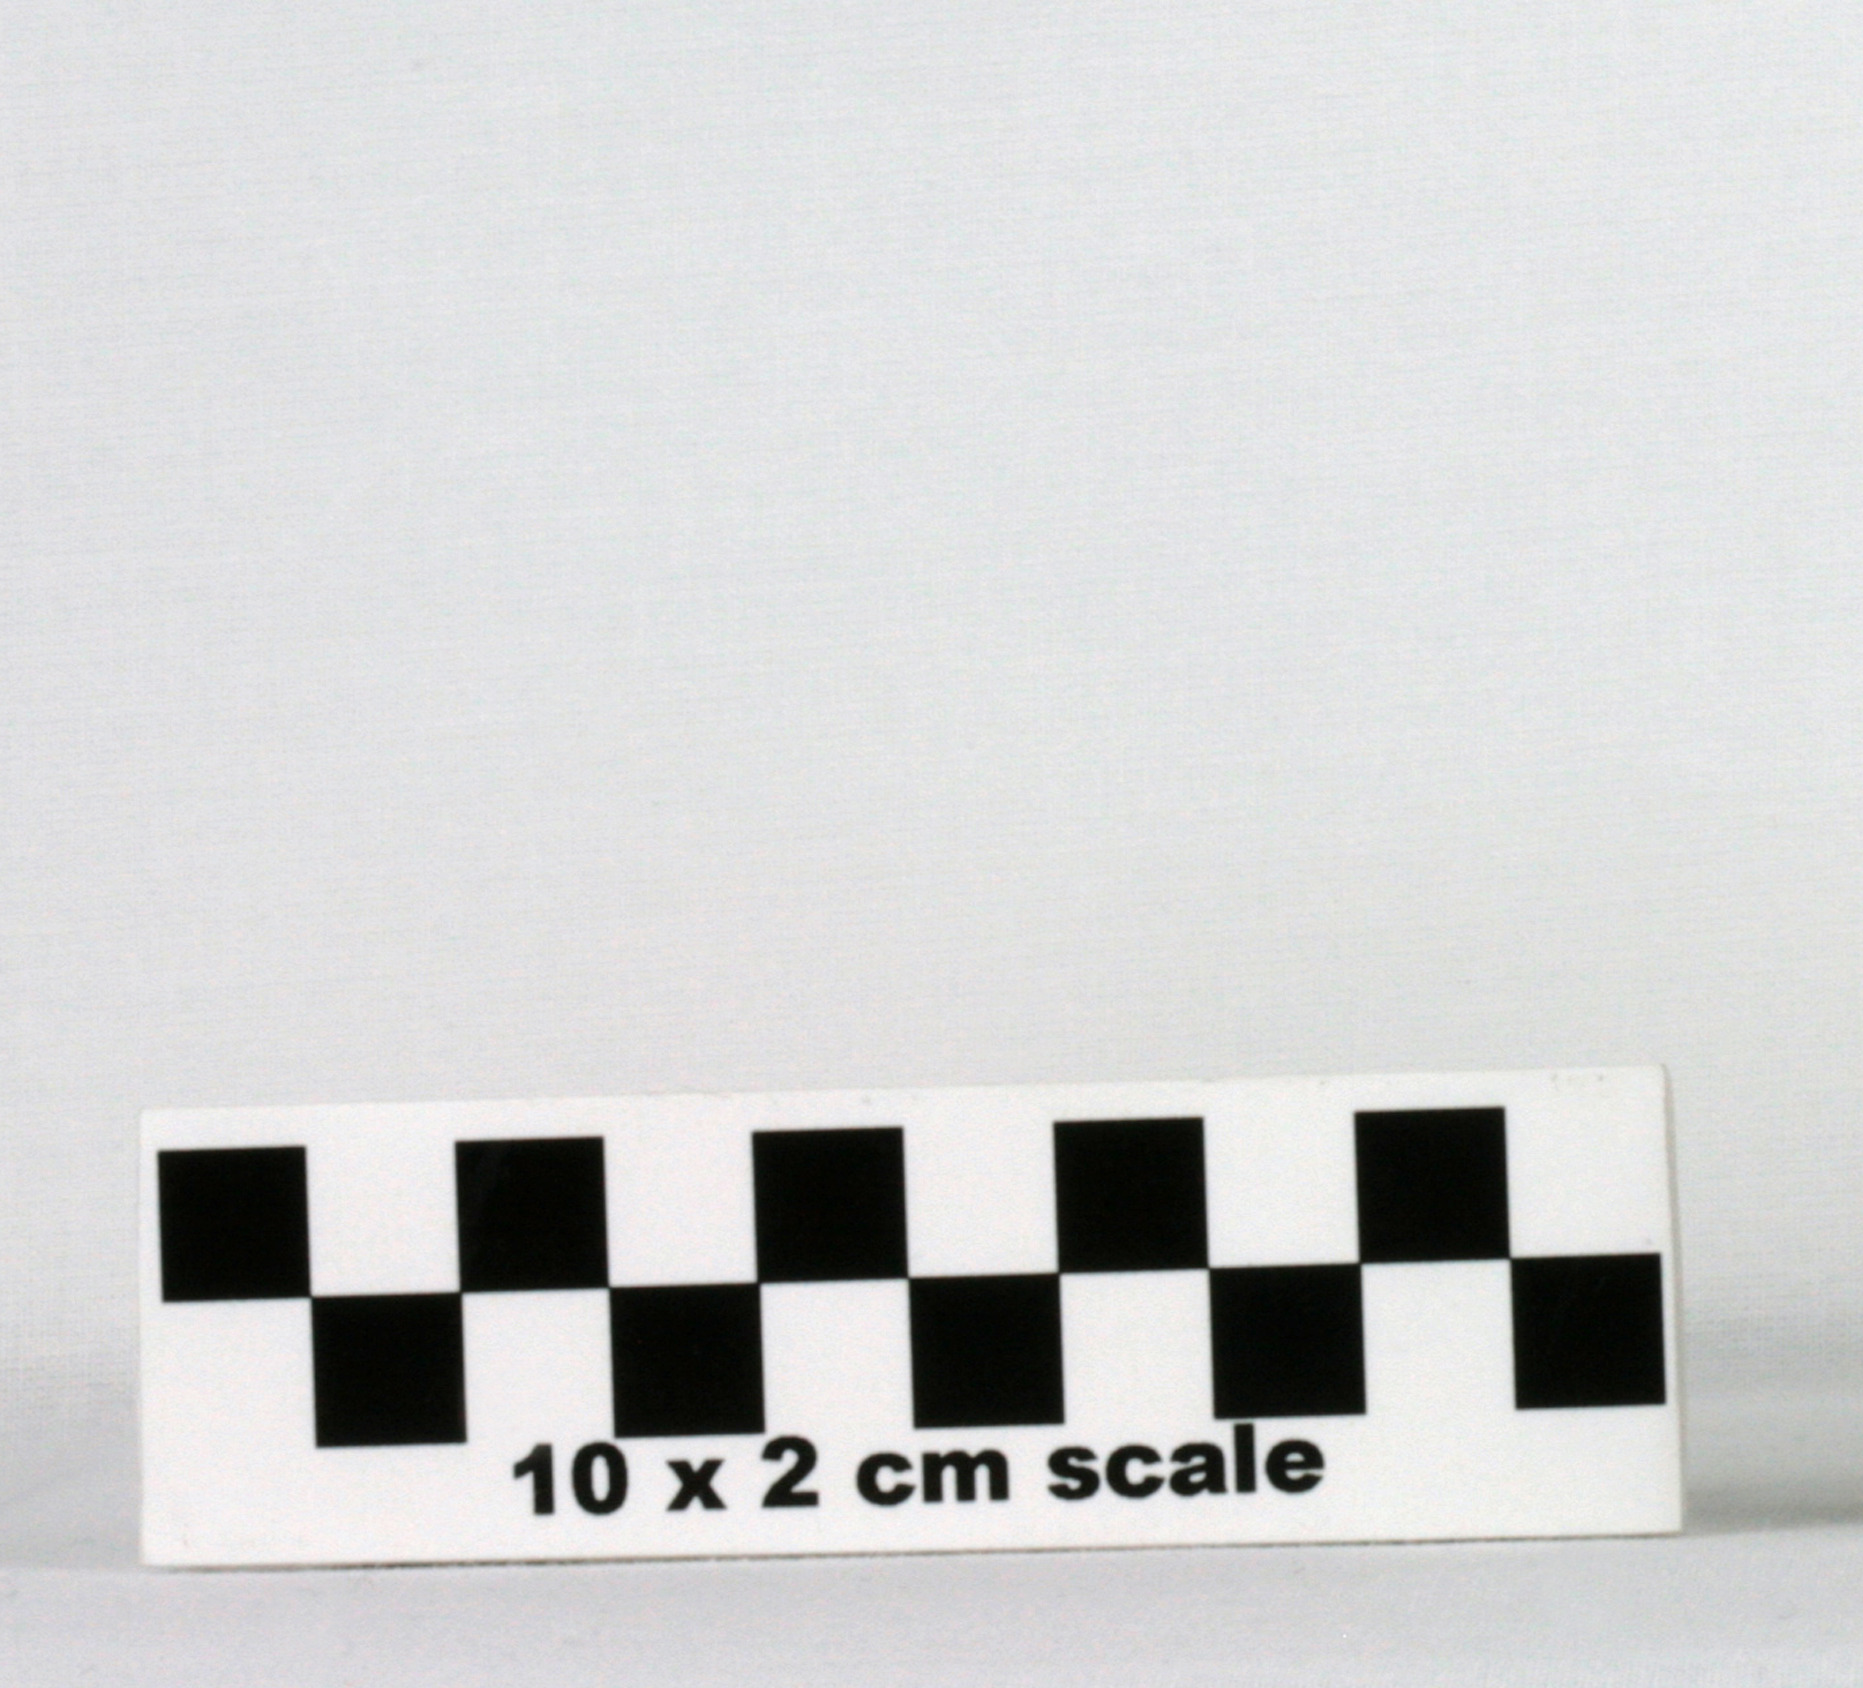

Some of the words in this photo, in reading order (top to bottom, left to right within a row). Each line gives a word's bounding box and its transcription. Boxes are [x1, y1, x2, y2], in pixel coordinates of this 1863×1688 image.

[512, 1441, 628, 1516] 10
[666, 1457, 727, 1511] x
[761, 1435, 820, 1508] 2
[856, 1447, 1011, 1506] cm
[1047, 1422, 1326, 1500] scale
